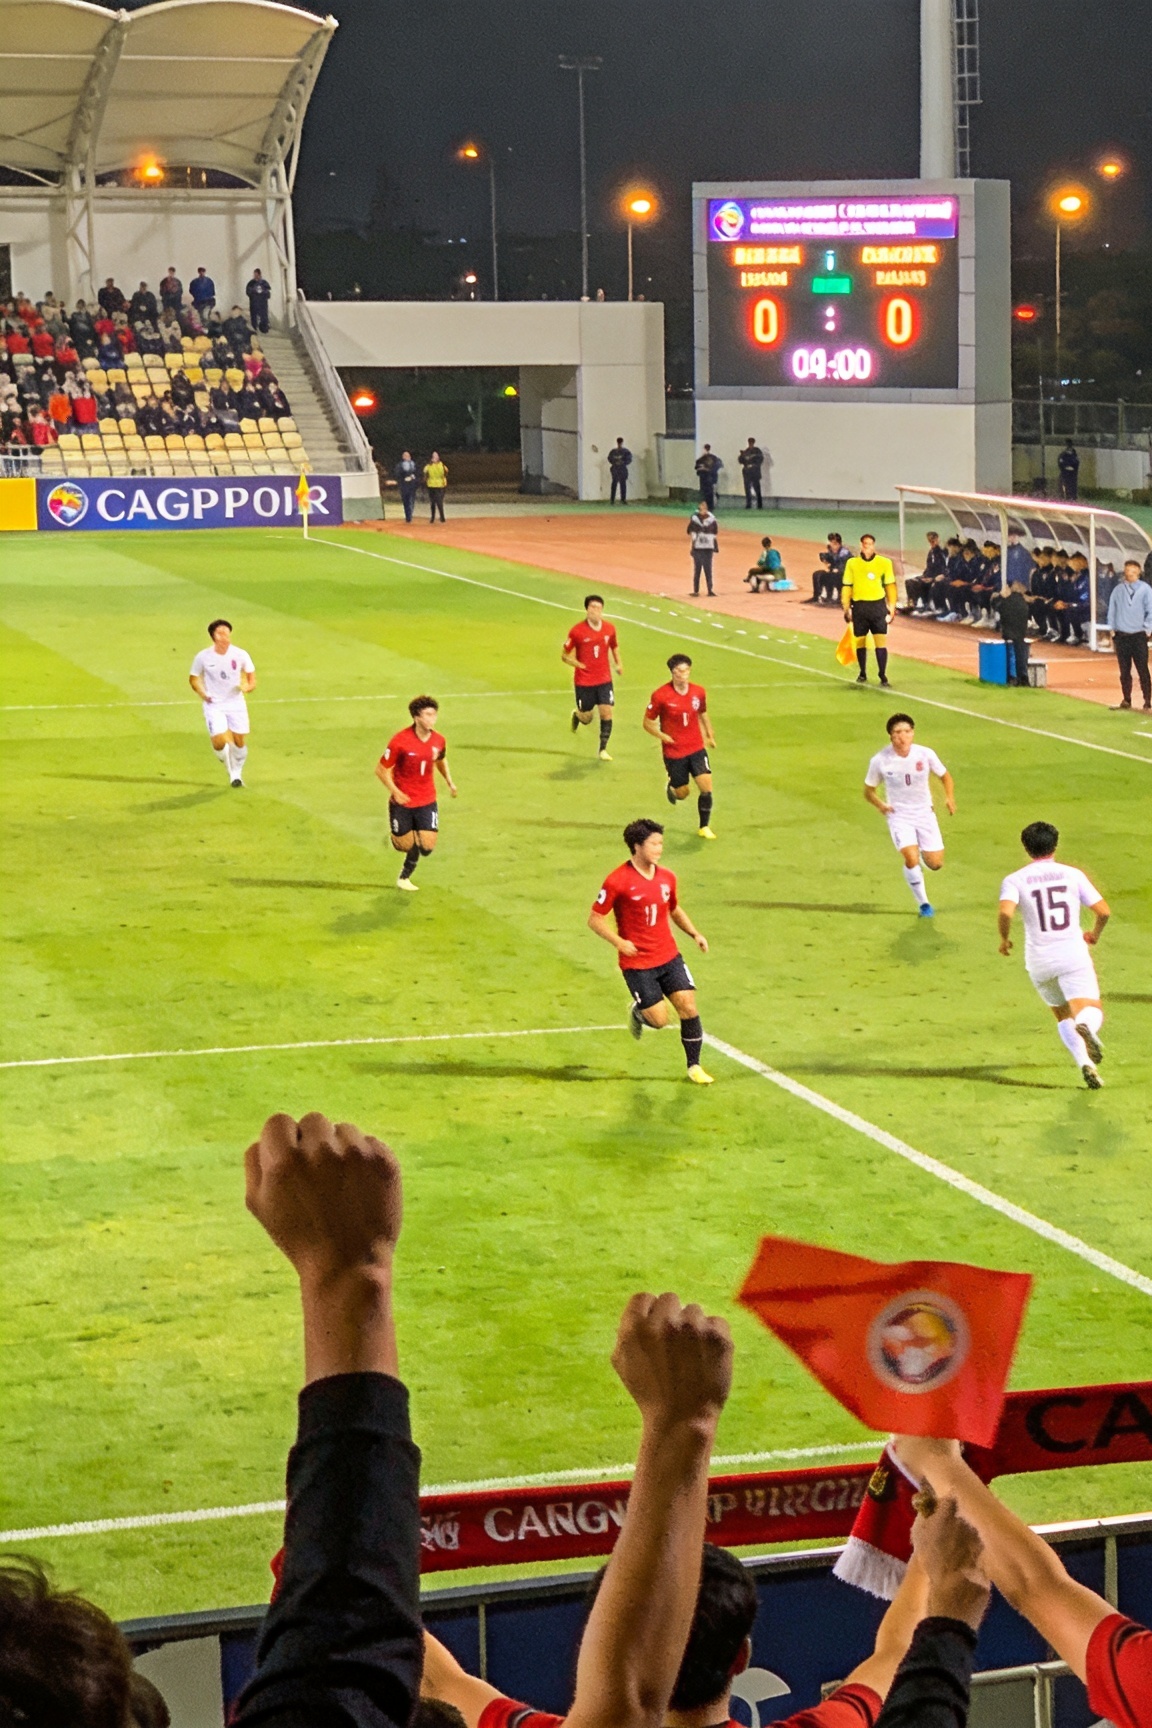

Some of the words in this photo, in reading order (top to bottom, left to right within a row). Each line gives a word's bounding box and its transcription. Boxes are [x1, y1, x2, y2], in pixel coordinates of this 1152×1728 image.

[753, 299, 779, 343] 0
[886, 298, 913, 344] 0
[1031, 885, 1070, 932] 15
